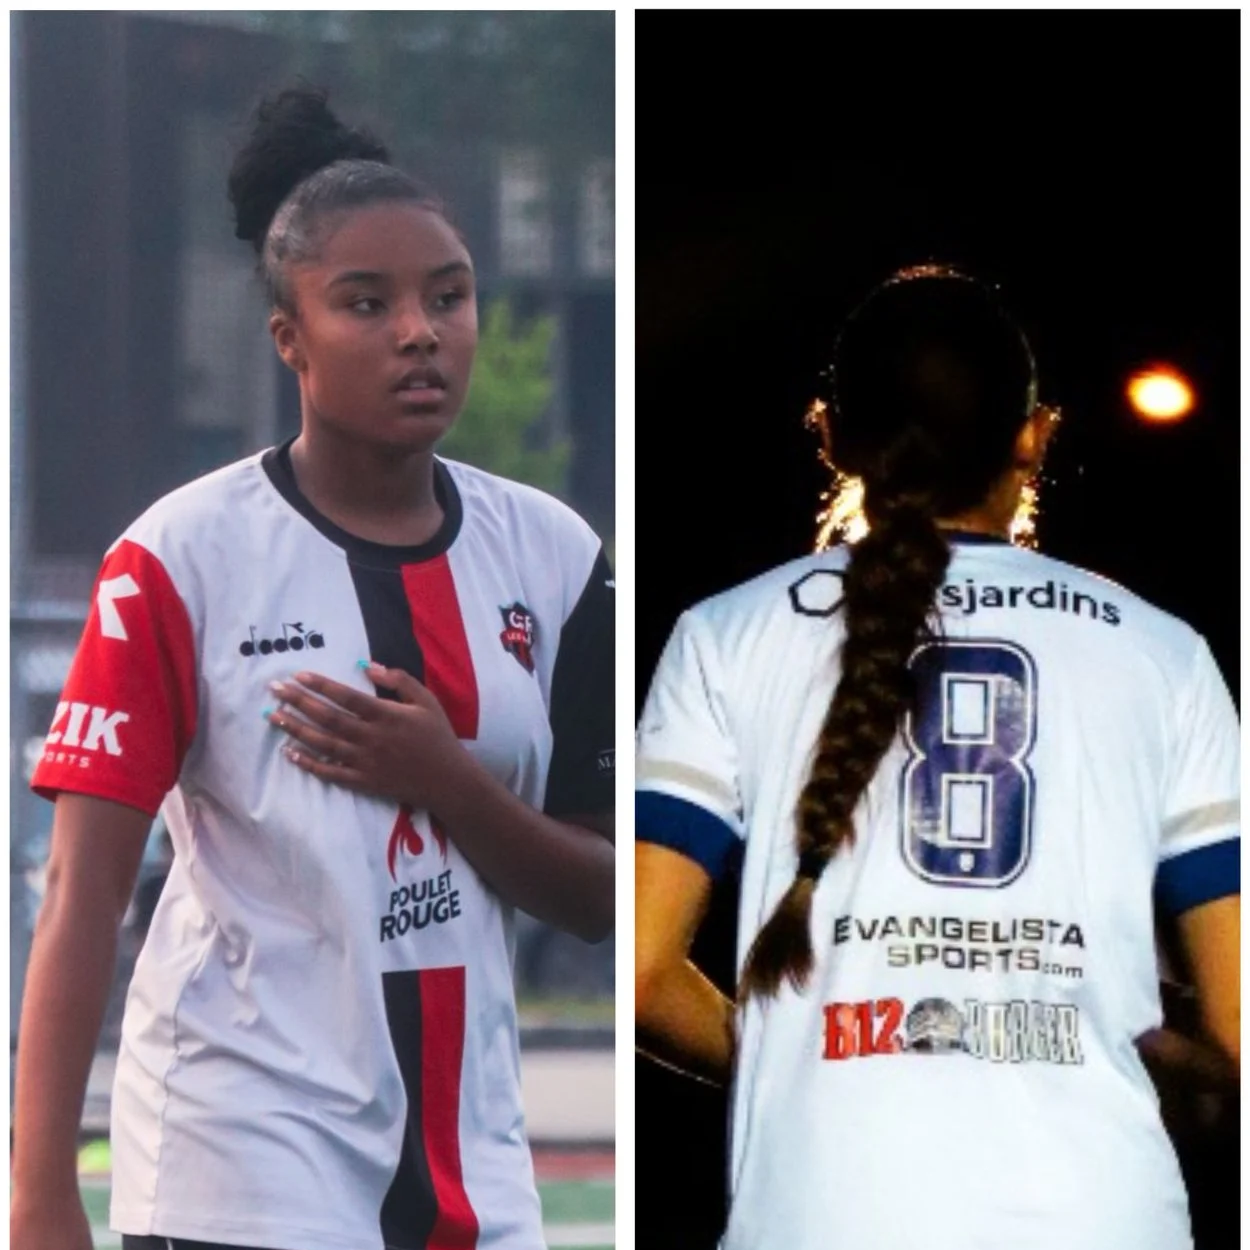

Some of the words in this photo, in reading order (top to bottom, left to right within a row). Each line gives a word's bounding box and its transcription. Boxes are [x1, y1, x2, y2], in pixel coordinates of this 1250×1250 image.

[941, 578, 1122, 627] sjardins
[239, 621, 326, 657] diadora
[899, 637, 1039, 889] 8
[390, 868, 452, 913] POULET
[380, 889, 462, 943] ROUGE
[833, 914, 1087, 949] EVANGELISTA
